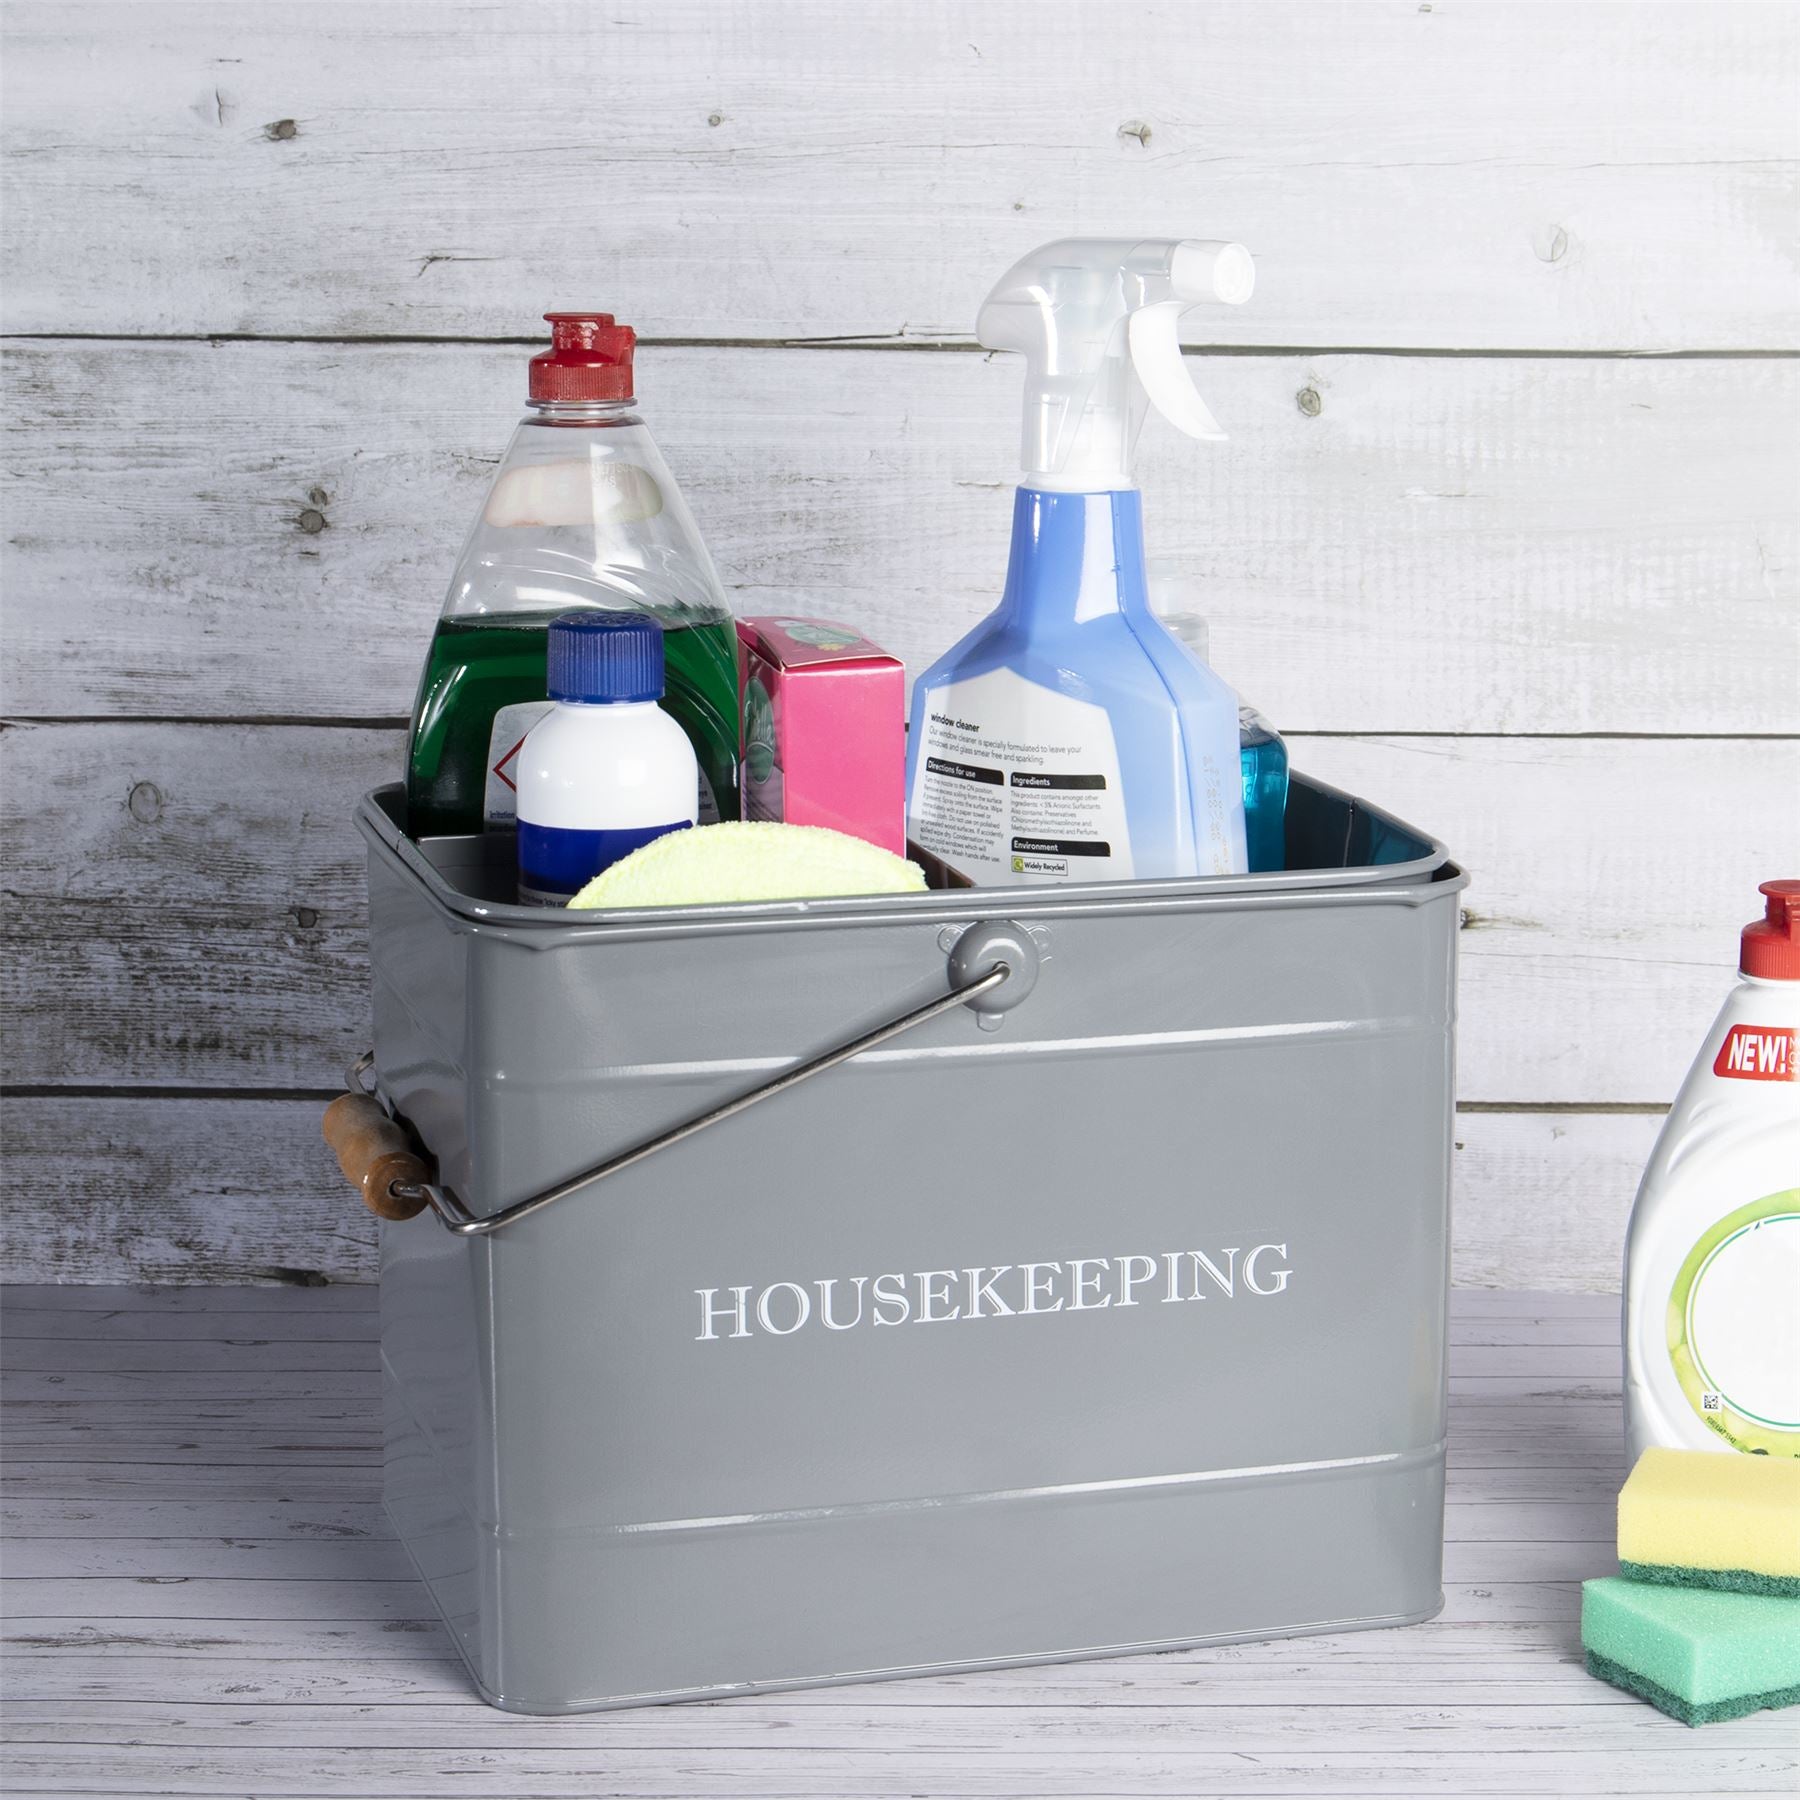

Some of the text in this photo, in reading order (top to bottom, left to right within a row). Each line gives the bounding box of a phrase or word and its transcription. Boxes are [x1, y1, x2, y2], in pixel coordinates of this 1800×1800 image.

[931, 713, 980, 732] window cleaner
[939, 730, 957, 740] window
[958, 733, 977, 743] cleaner
[983, 739, 1006, 751] specially
[1007, 742, 1039, 753] formulated
[1067, 747, 1081, 756] your
[928, 738, 948, 748] windows
[950, 743, 959, 751] and
[960, 745, 973, 754] glass
[974, 749, 990, 757] smear
[991, 750, 1002, 760] free
[1004, 753, 1015, 761] and
[928, 760, 955, 774] Directions
[956, 766, 965, 775] for
[1013, 776, 1050, 787] Ingredients
[954, 790, 967, 800] soiling
[942, 796, 954, 805] Spray
[991, 805, 1003, 813] Wipe
[959, 809, 971, 817] paper
[980, 820, 1000, 829] polished
[953, 833, 984, 843] Condensation
[945, 840, 964, 849] windows
[1014, 840, 1058, 851] Environment
[1025, 862, 1065, 871] Widely Recycled
[1727, 1033, 1787, 1073] NEW!
[694, 1243, 1293, 1341] HOUSEKEEPING
